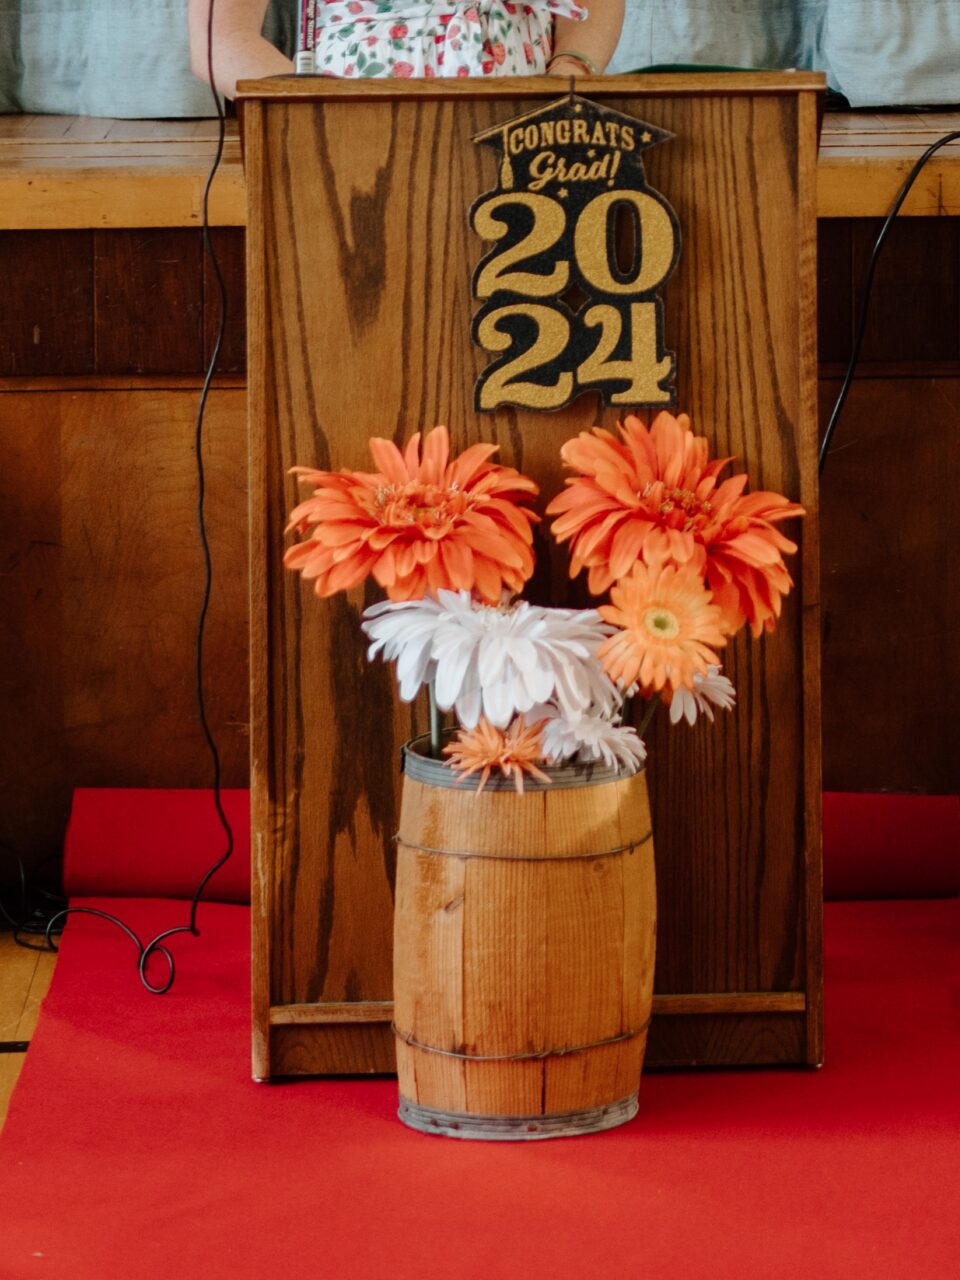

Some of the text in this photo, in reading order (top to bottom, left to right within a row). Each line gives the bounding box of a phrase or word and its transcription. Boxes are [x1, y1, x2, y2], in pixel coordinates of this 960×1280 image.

[306, 20, 315, 48] Stands
[509, 119, 635, 154] CONGRATS
[528, 150, 622, 191] Grad!
[474, 189, 675, 299] 20
[478, 302, 673, 409] 24
